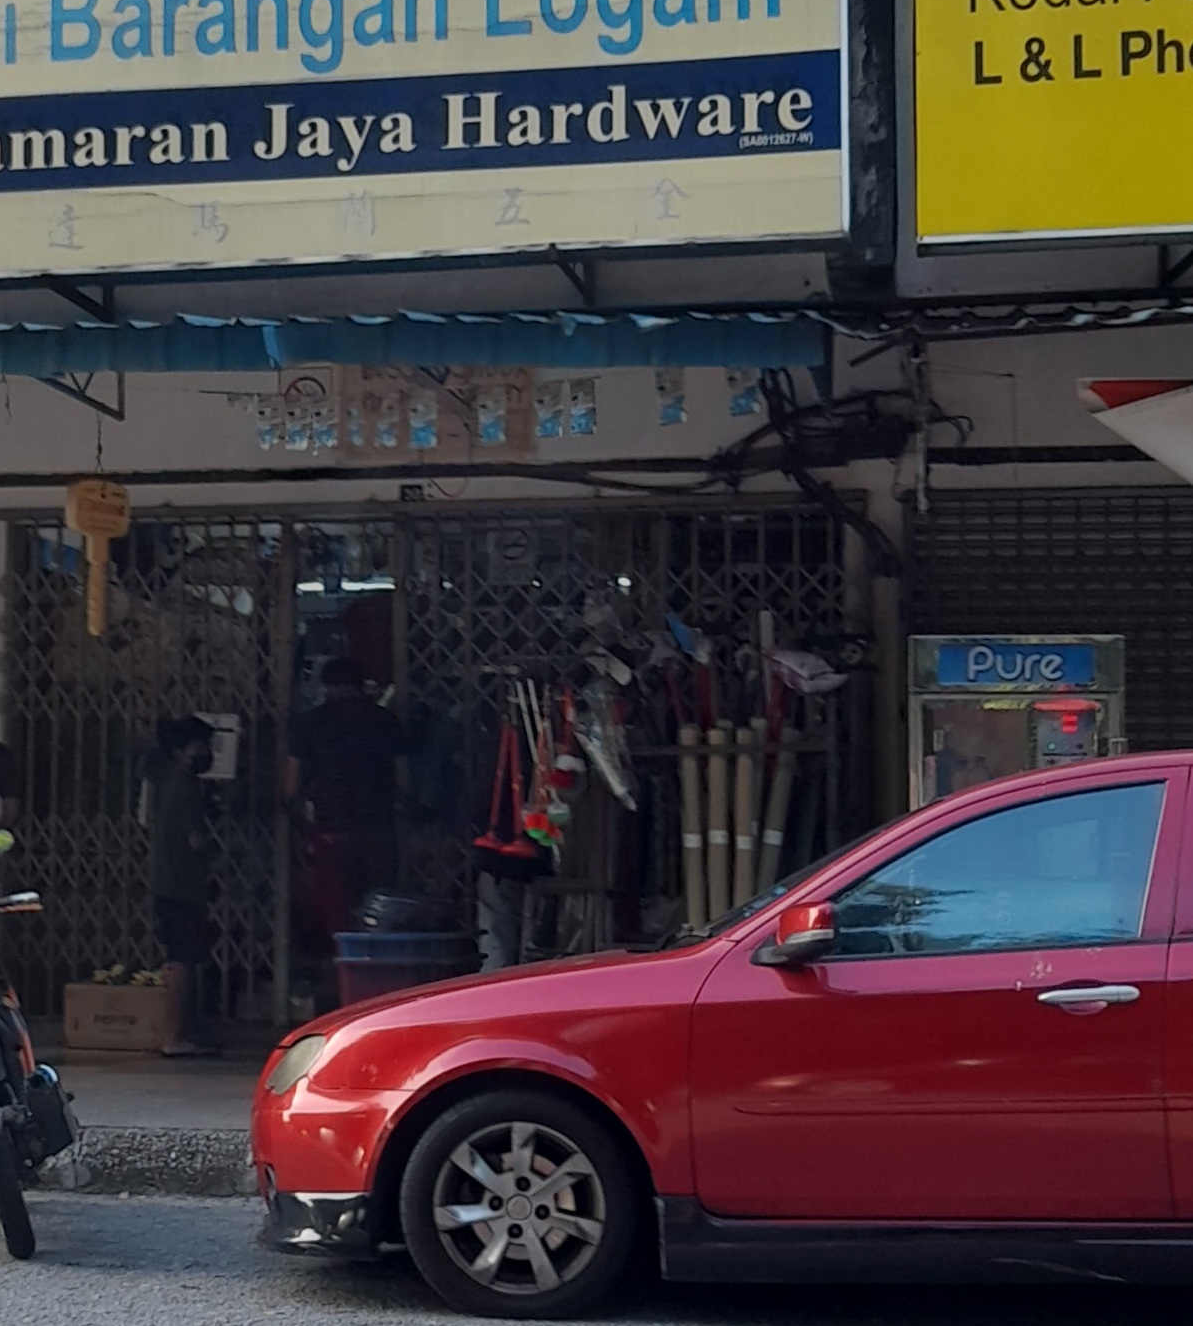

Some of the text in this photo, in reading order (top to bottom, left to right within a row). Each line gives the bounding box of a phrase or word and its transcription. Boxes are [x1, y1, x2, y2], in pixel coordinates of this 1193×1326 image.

[974, 28, 1193, 85] L & L Ph
[253, 103, 417, 173] Jaya
[441, 85, 814, 151] Hardware
[967, 646, 1065, 681] Pure
